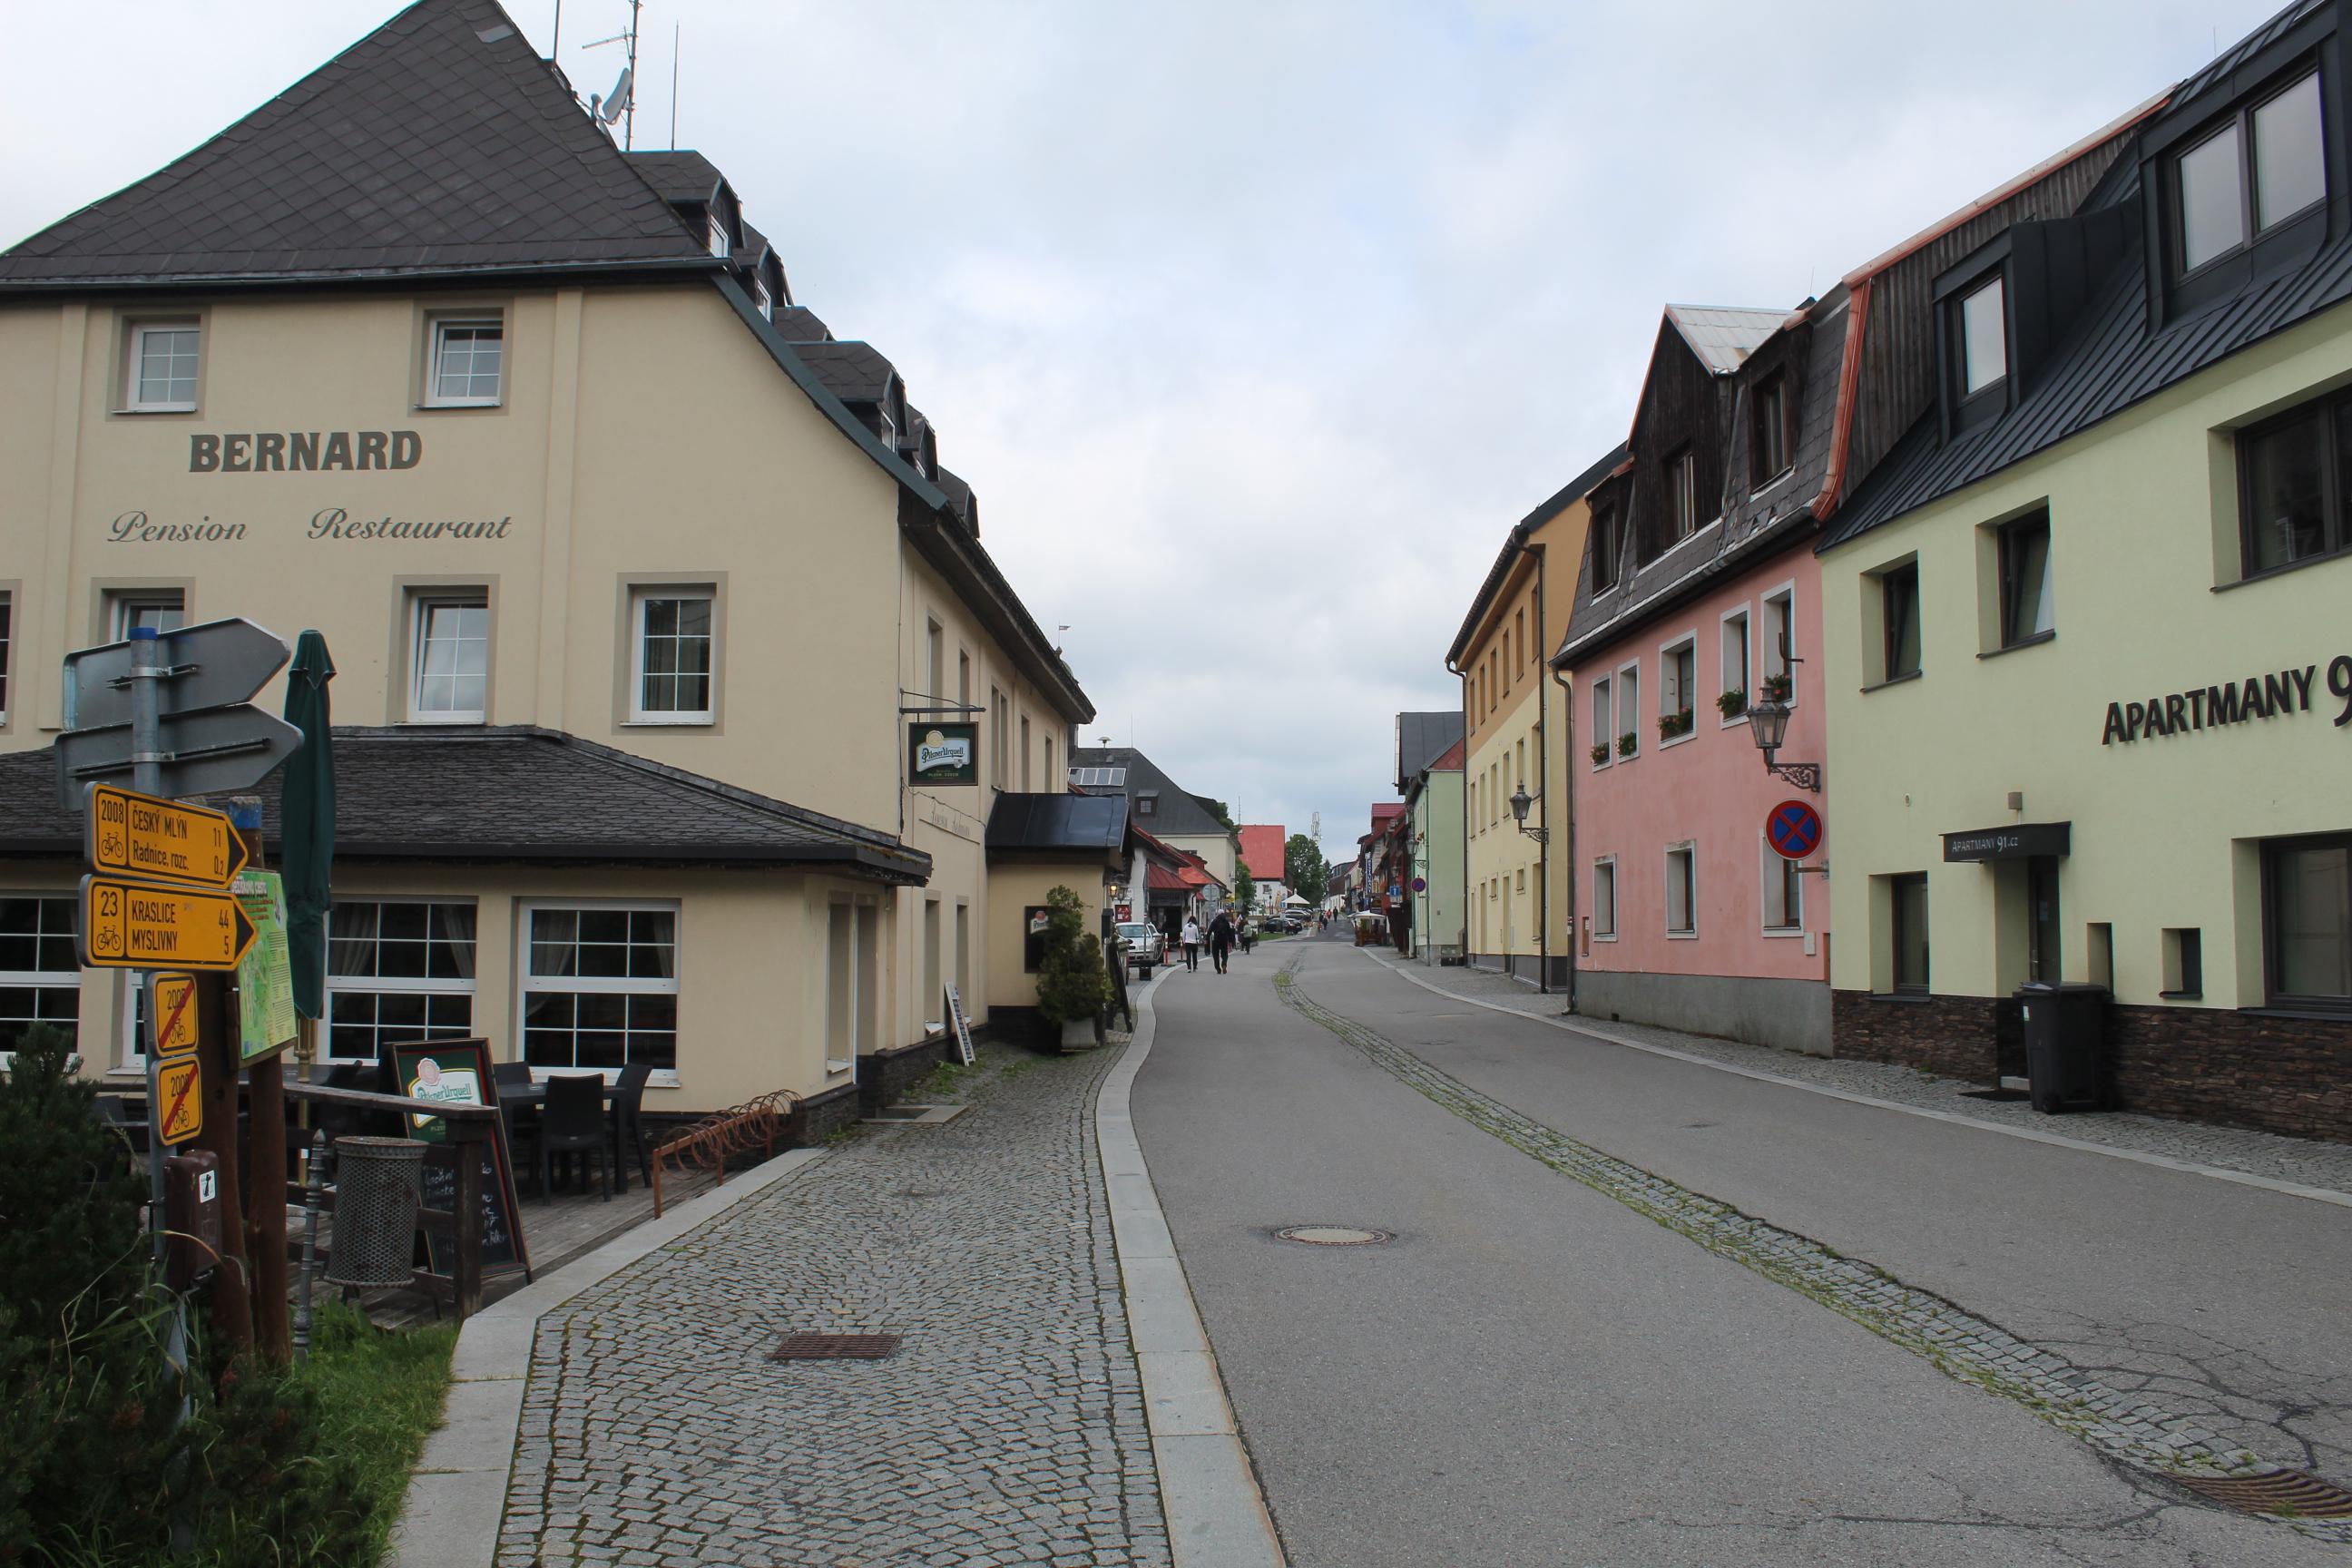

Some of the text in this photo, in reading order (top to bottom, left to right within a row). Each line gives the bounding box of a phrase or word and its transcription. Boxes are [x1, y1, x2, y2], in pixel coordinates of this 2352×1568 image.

[189, 431, 422, 472] BERNARD
[107, 507, 512, 543] Pension Restaurant
[2102, 664, 2316, 746] APARTMANY
[922, 747, 964, 763] Pilsner Urquell
[102, 799, 123, 824] 2008
[132, 804, 221, 848] ČESKÝ MLÝN 11
[1952, 838, 1994, 852] APARTMANY
[171, 853, 189, 871] rozc.
[101, 891, 118, 916] 23
[132, 899, 229, 929] KRASLICE 44
[132, 929, 230, 956] MYSLIVNY 5
[444, 1083, 472, 1101] Urquell
